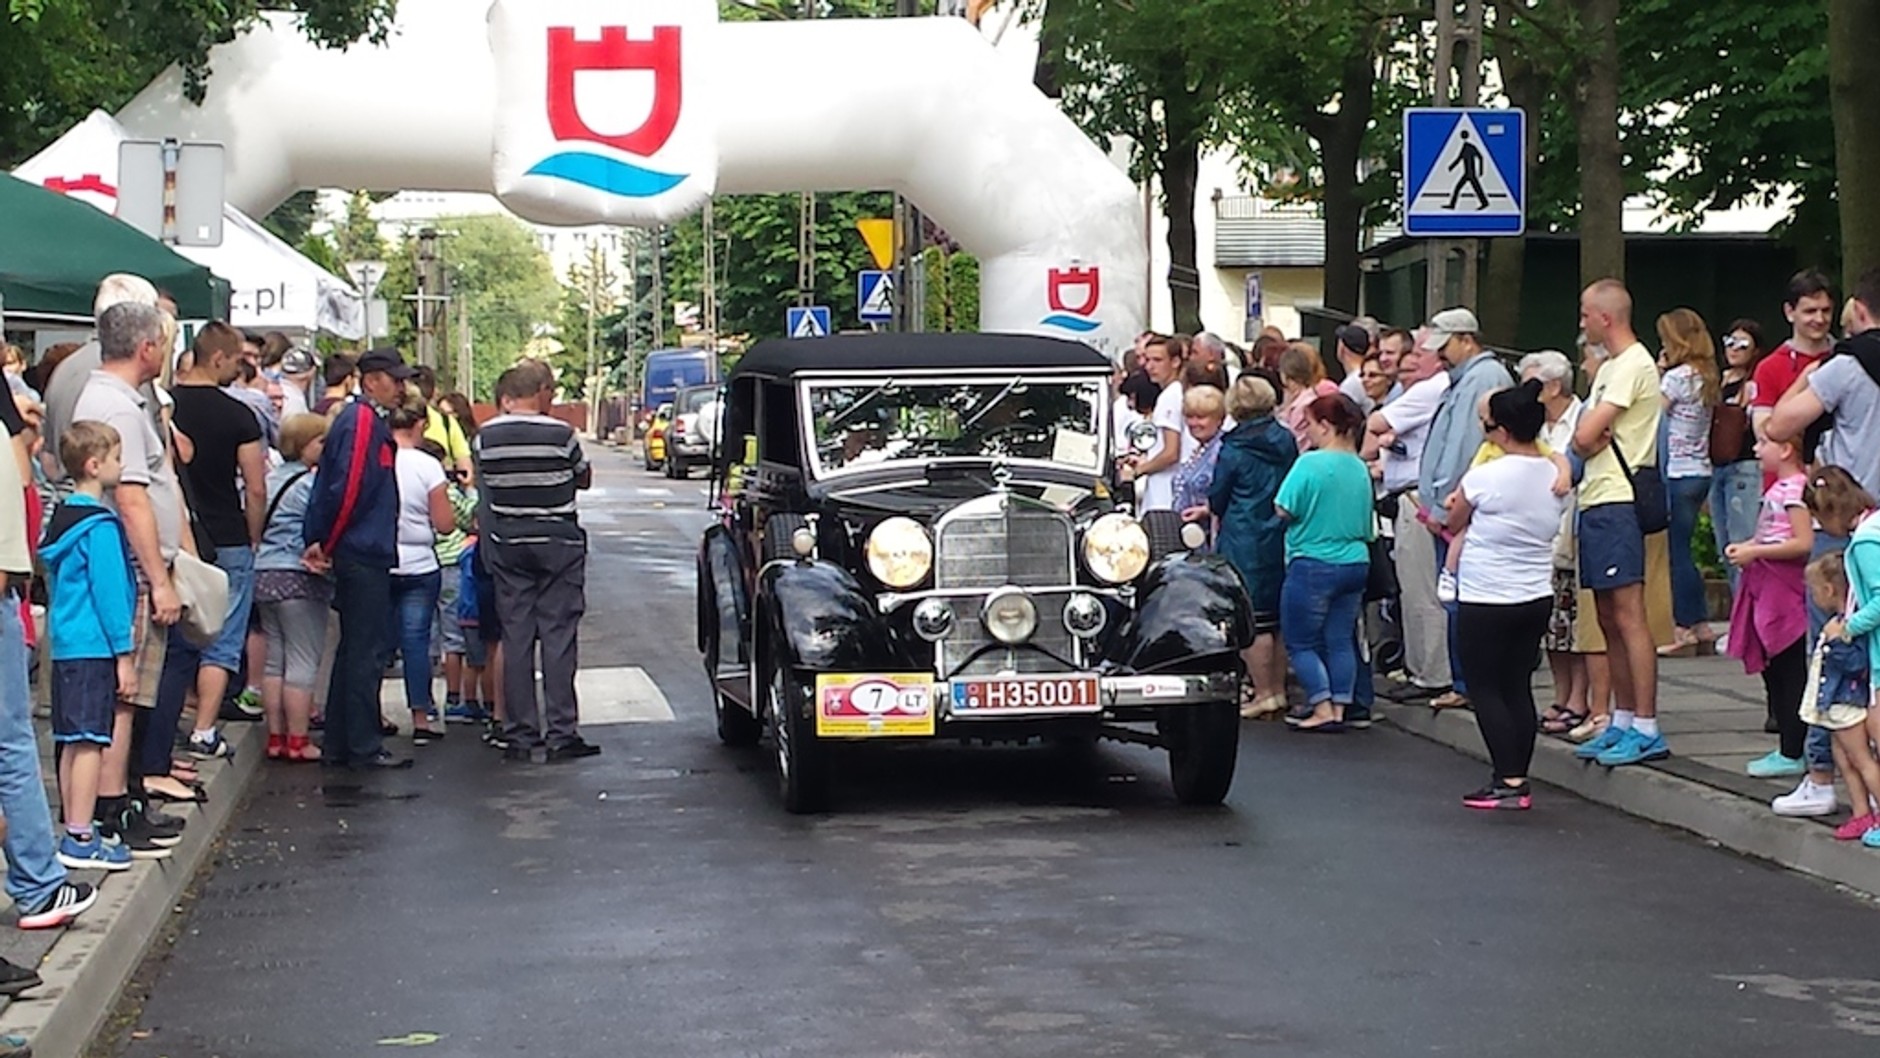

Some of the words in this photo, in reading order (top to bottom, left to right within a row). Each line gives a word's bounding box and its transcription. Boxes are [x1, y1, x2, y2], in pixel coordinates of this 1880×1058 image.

[230, 282, 285, 316] .pl
[870, 688, 883, 709] 7
[905, 694, 922, 707] LT
[986, 680, 1087, 707] H35001
